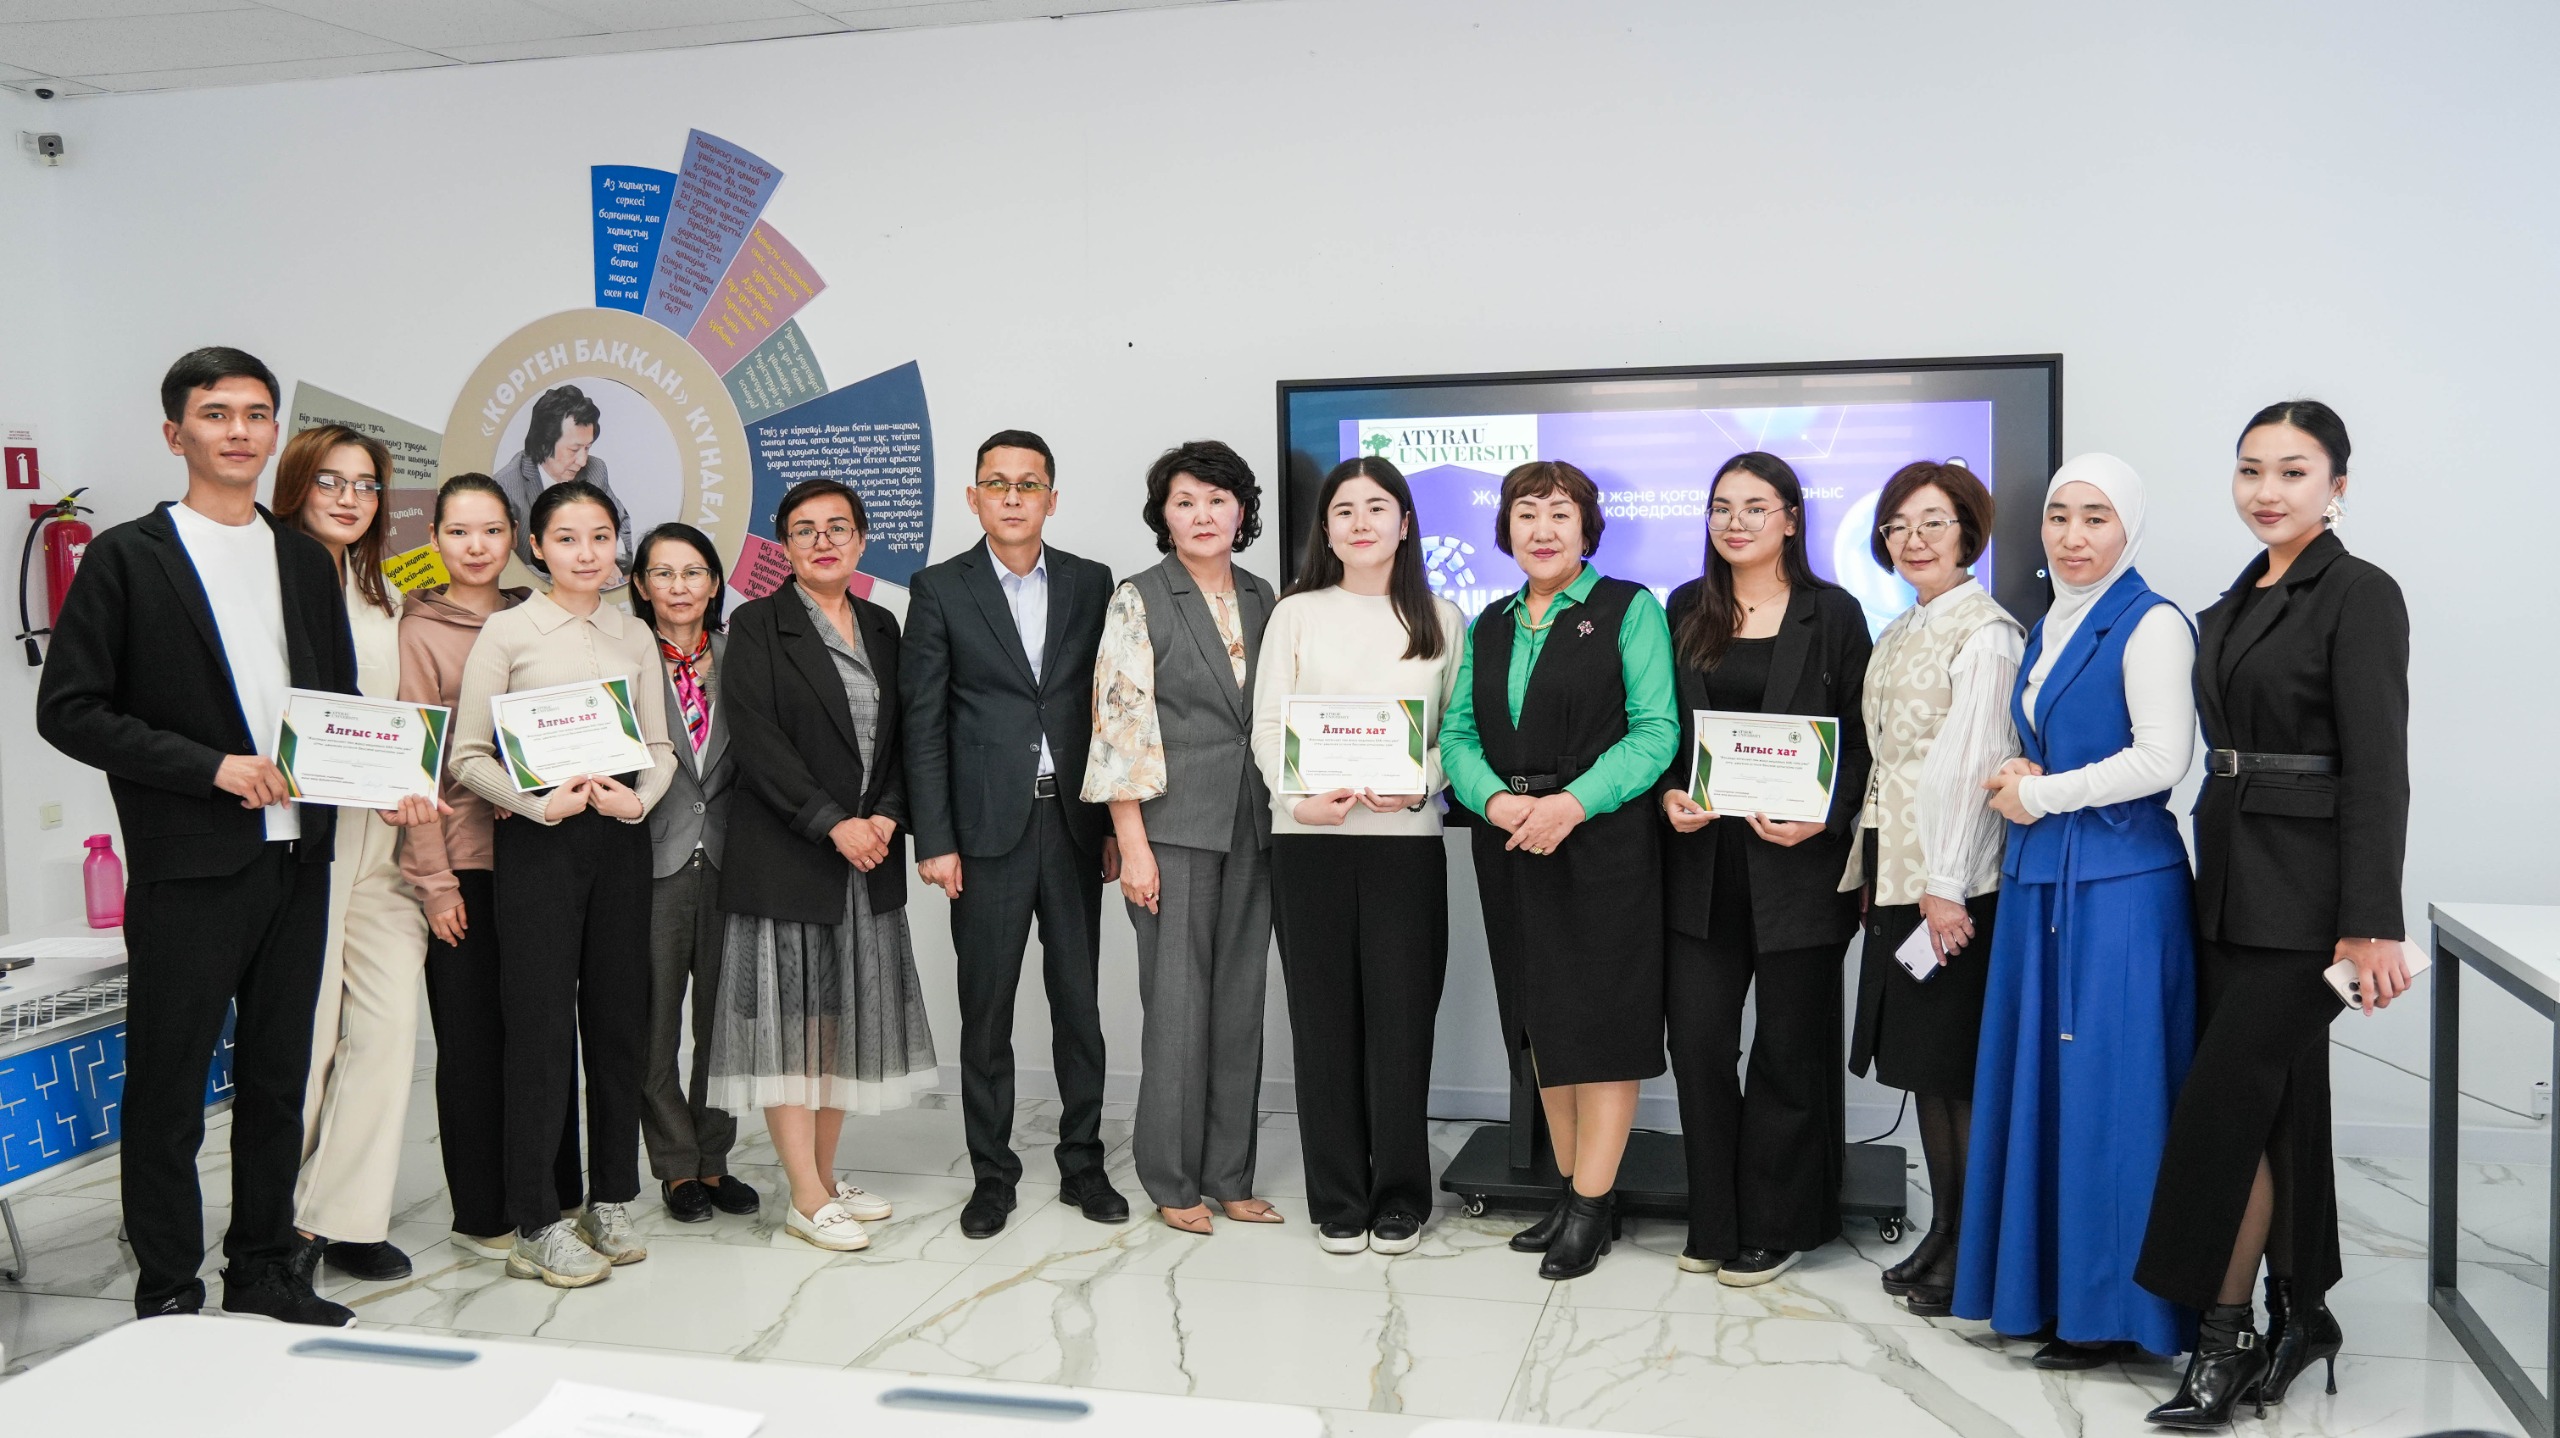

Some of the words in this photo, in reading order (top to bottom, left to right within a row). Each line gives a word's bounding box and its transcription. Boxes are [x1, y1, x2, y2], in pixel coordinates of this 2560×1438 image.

[603, 177, 615, 190] Аз
[617, 180, 660, 194] халықтың
[615, 194, 645, 208] серкесі
[598, 208, 643, 223] болғаннан,
[644, 214, 659, 223] көп
[606, 226, 649, 240] халықтың
[612, 240, 639, 255] еркесі
[610, 257, 638, 268] болған
[608, 273, 637, 285] жақсы
[603, 288, 621, 297] екен
[624, 290, 638, 299] ғой
[481, 342, 570, 437] «КӨРГЕН
[758, 426, 777, 438] Теңіз
[779, 428, 788, 436] де
[790, 424, 822, 437] кірлейді.
[824, 423, 850, 435] Айдын
[851, 422, 871, 432] бетін
[1398, 428, 1485, 446] ATYRAU
[787, 438, 807, 446] ағаш,
[810, 436, 829, 444] өлген
[831, 433, 856, 445] балық
[891, 430, 920, 441] төгілген
[761, 448, 784, 460] мұнай
[852, 443, 890, 456] Күндердің
[891, 441, 921, 454] күнінде
[1400, 444, 1533, 463] UNIVERSITY
[766, 460, 789, 470] дауыл
[833, 456, 860, 466] Толқын
[863, 455, 886, 464] біткен
[889, 455, 921, 465] арыстан
[861, 477, 899, 488] қоқыстың
[901, 474, 922, 486] бәрін
[1610, 490, 1655, 503] және
[1660, 489, 1710, 504] қоғам
[1801, 486, 1844, 499] аныс
[872, 508, 922, 521] жарқырайды
[1605, 503, 1706, 520] кафедрасы
[873, 521, 895, 531] қоғам
[898, 522, 907, 530] да
[888, 541, 908, 553] күтіп
[911, 543, 924, 552] тұр
[578, 712, 598, 722] хат
[376, 731, 399, 742] хат
[1366, 727, 1387, 735] хат
[1777, 749, 1798, 757] хат
